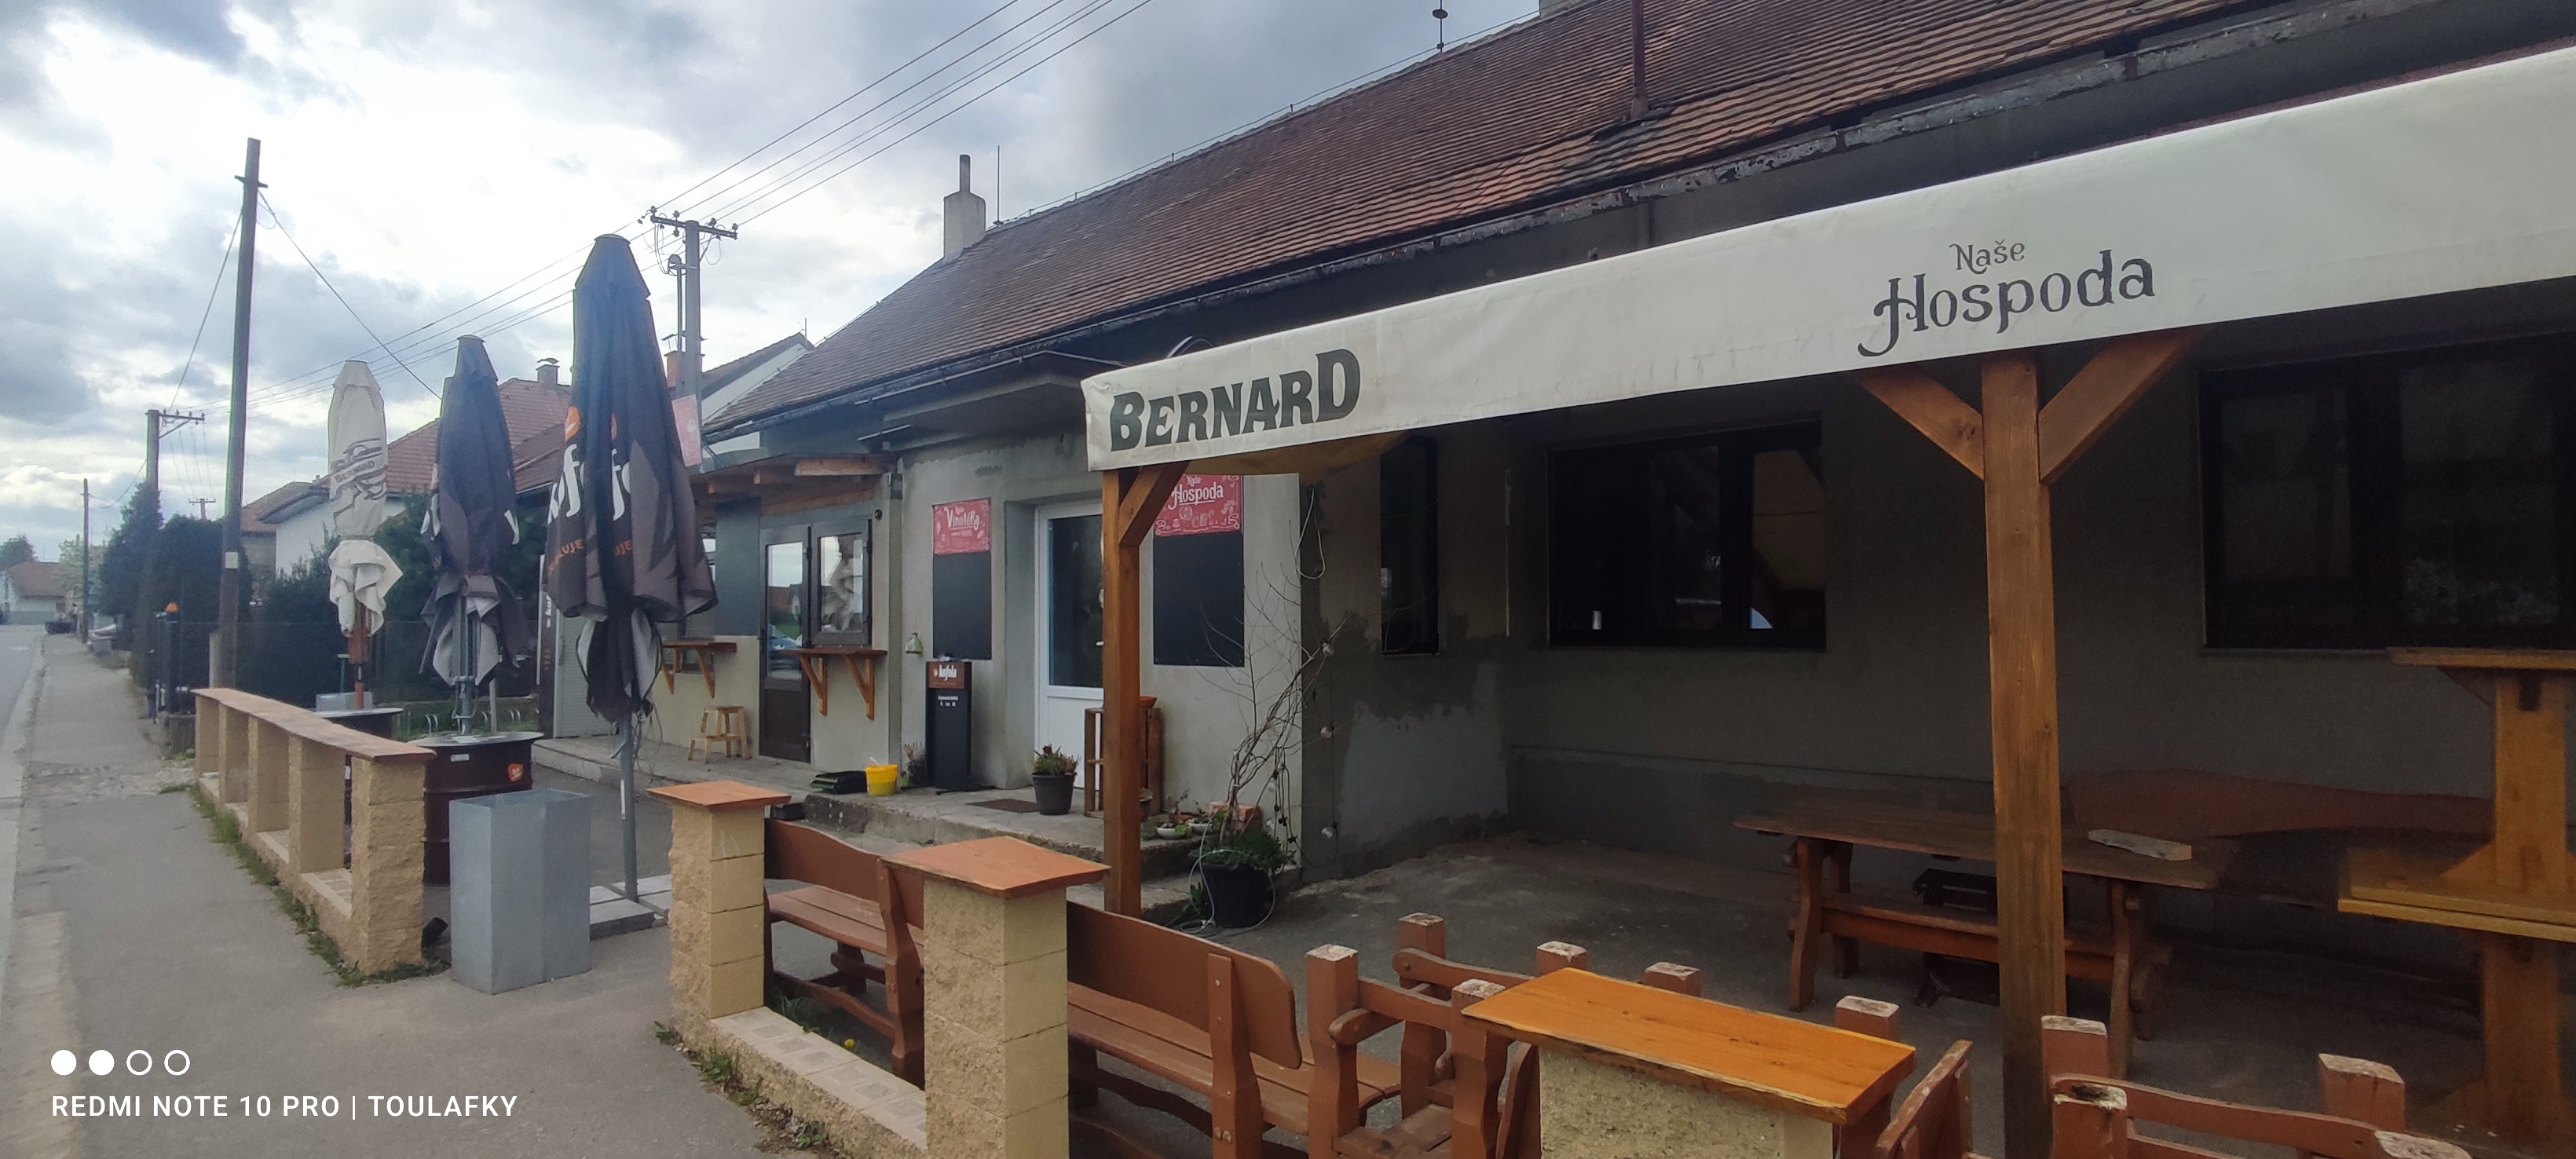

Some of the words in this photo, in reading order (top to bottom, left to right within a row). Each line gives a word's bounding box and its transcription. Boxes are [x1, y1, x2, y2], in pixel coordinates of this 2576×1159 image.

[1949, 239, 2025, 275] Naše
[1857, 249, 2156, 357] Hospoda
[1110, 349, 1361, 452] BERNARD
[1167, 481, 1224, 510] Hospoda
